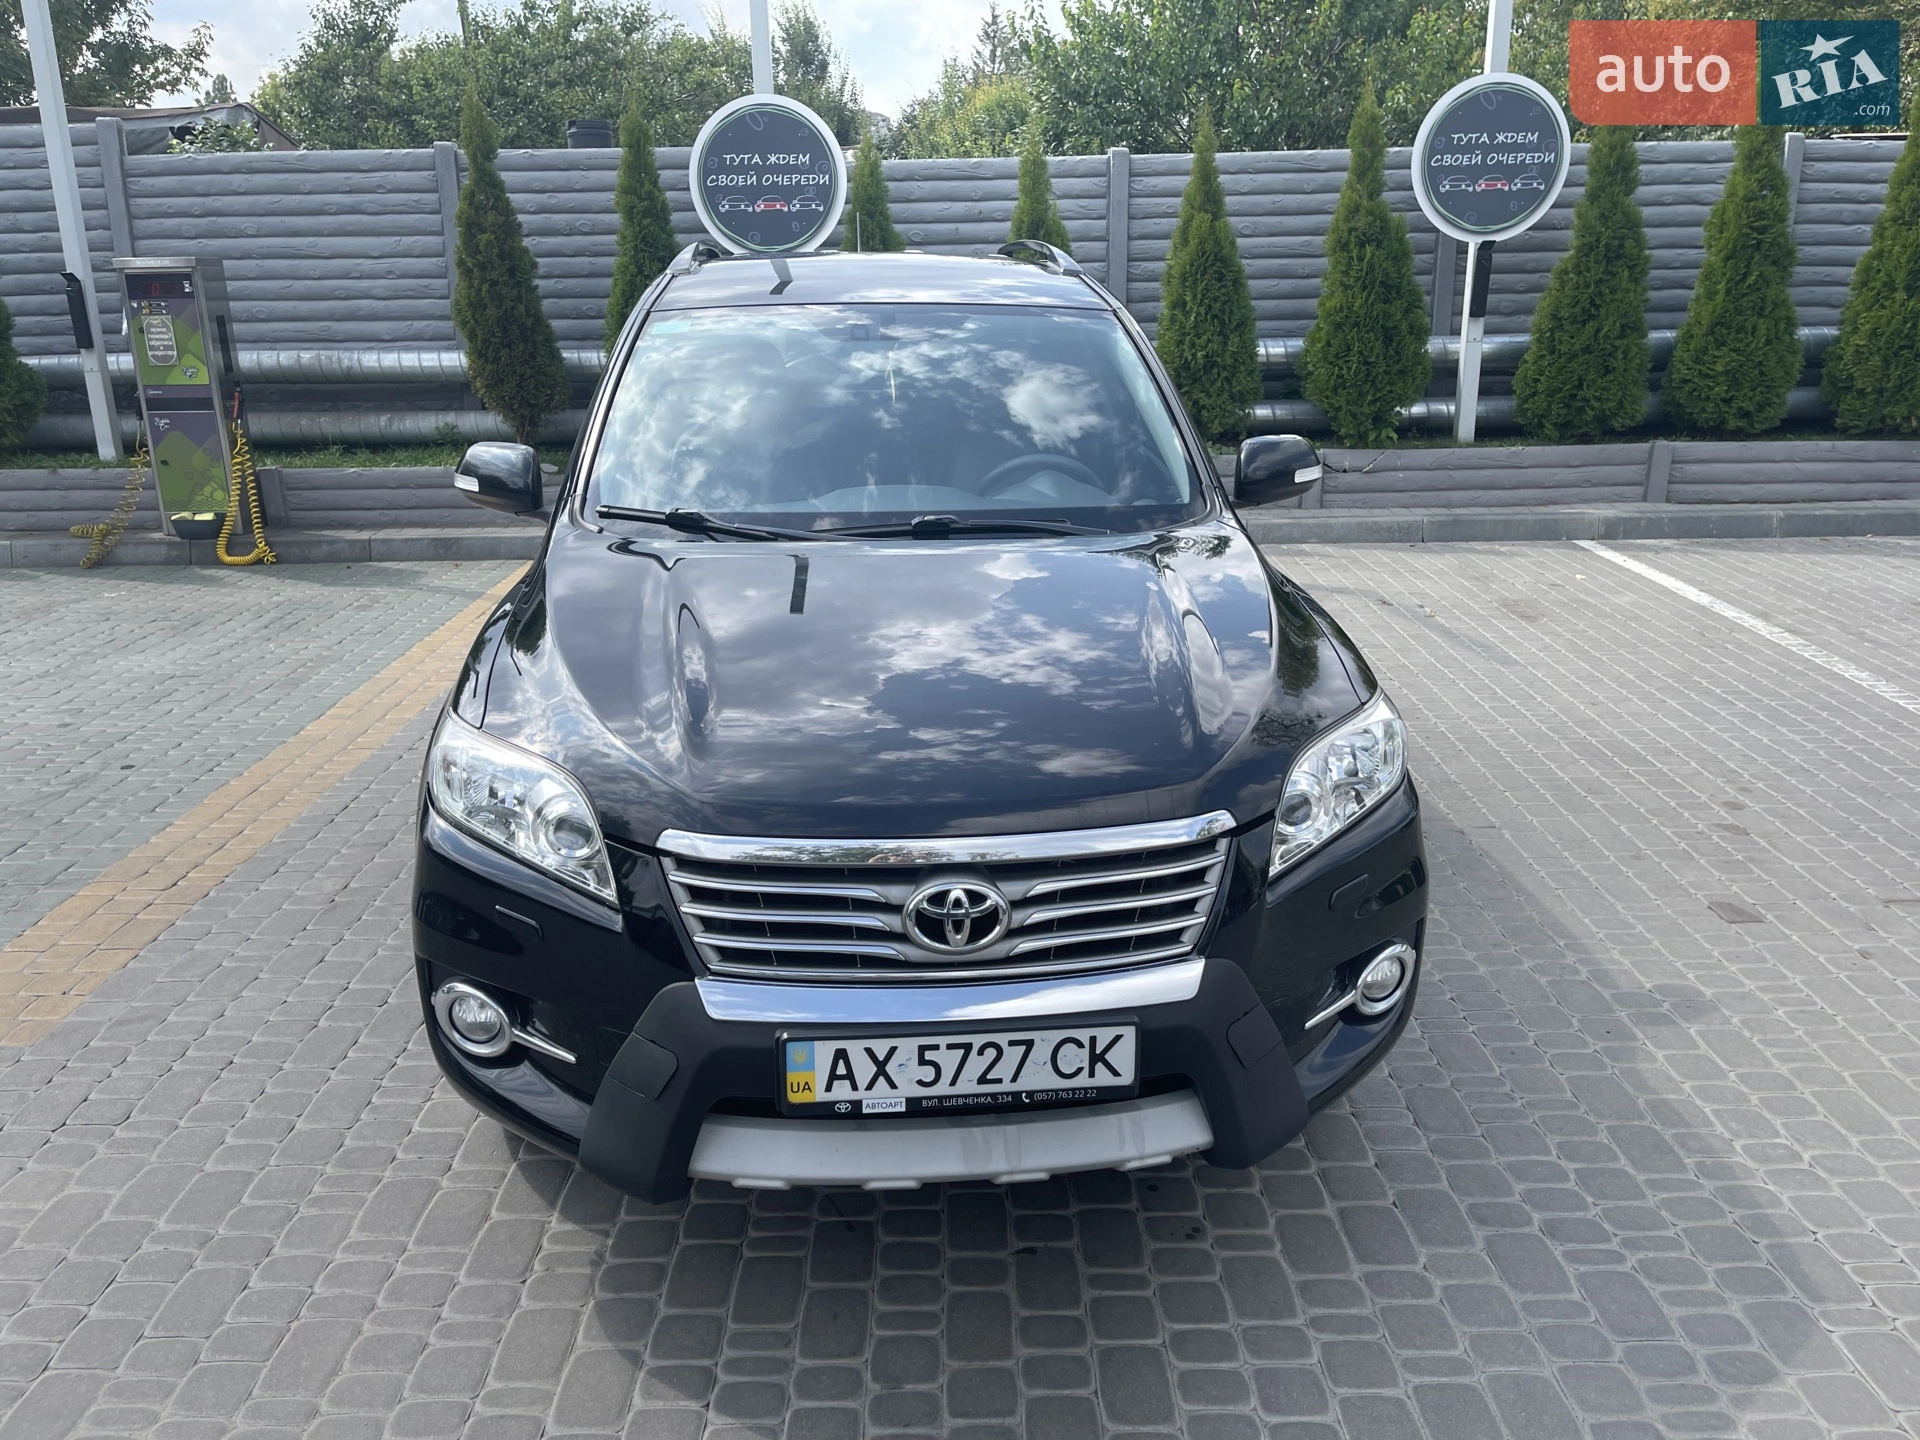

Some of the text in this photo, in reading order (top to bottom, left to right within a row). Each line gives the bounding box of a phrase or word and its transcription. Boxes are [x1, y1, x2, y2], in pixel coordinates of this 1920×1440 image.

[1451, 131, 1539, 145] ТУТА ЖДЕМ
[722, 153, 810, 166] ТУТА ЖДЕМ
[1430, 150, 1556, 167] СВОЕЙ ОЧЕРЕДИ
[706, 171, 830, 187] СВОЕЙ ОЧЕРЕДИ
[824, 1034, 1125, 1093] AX 5727 CK
[790, 1081, 813, 1095] UA
[1034, 1089, 1097, 1101] (057) 763 22 22
[864, 1100, 904, 1110] АВТОАРТ
[922, 1094, 1012, 1108] ВУЛ. ШЕВЧЕНКА, 334
